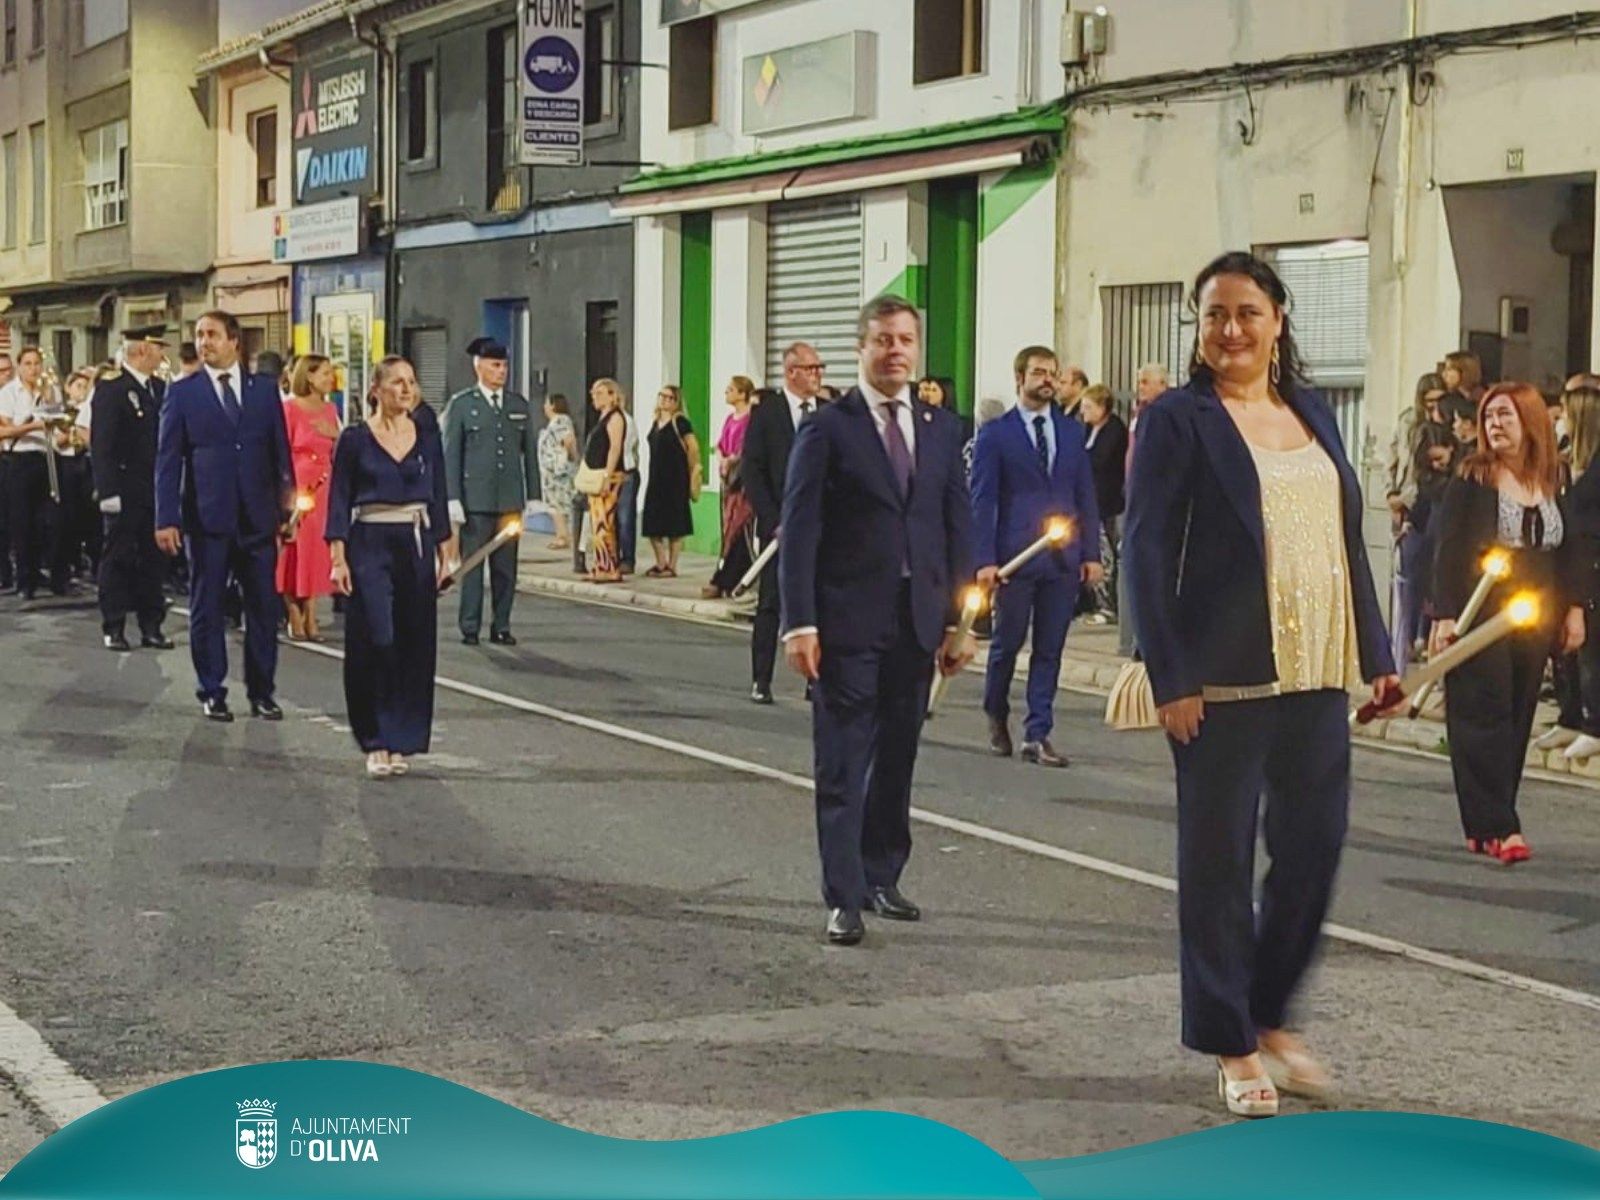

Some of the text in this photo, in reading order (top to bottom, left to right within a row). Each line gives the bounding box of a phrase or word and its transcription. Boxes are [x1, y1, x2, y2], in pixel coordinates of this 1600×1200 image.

[526, 0, 582, 28] HOME
[318, 99, 359, 133] ELECTRIC
[525, 131, 577, 142] CLIENTES
[309, 145, 367, 188] DAIKIN
